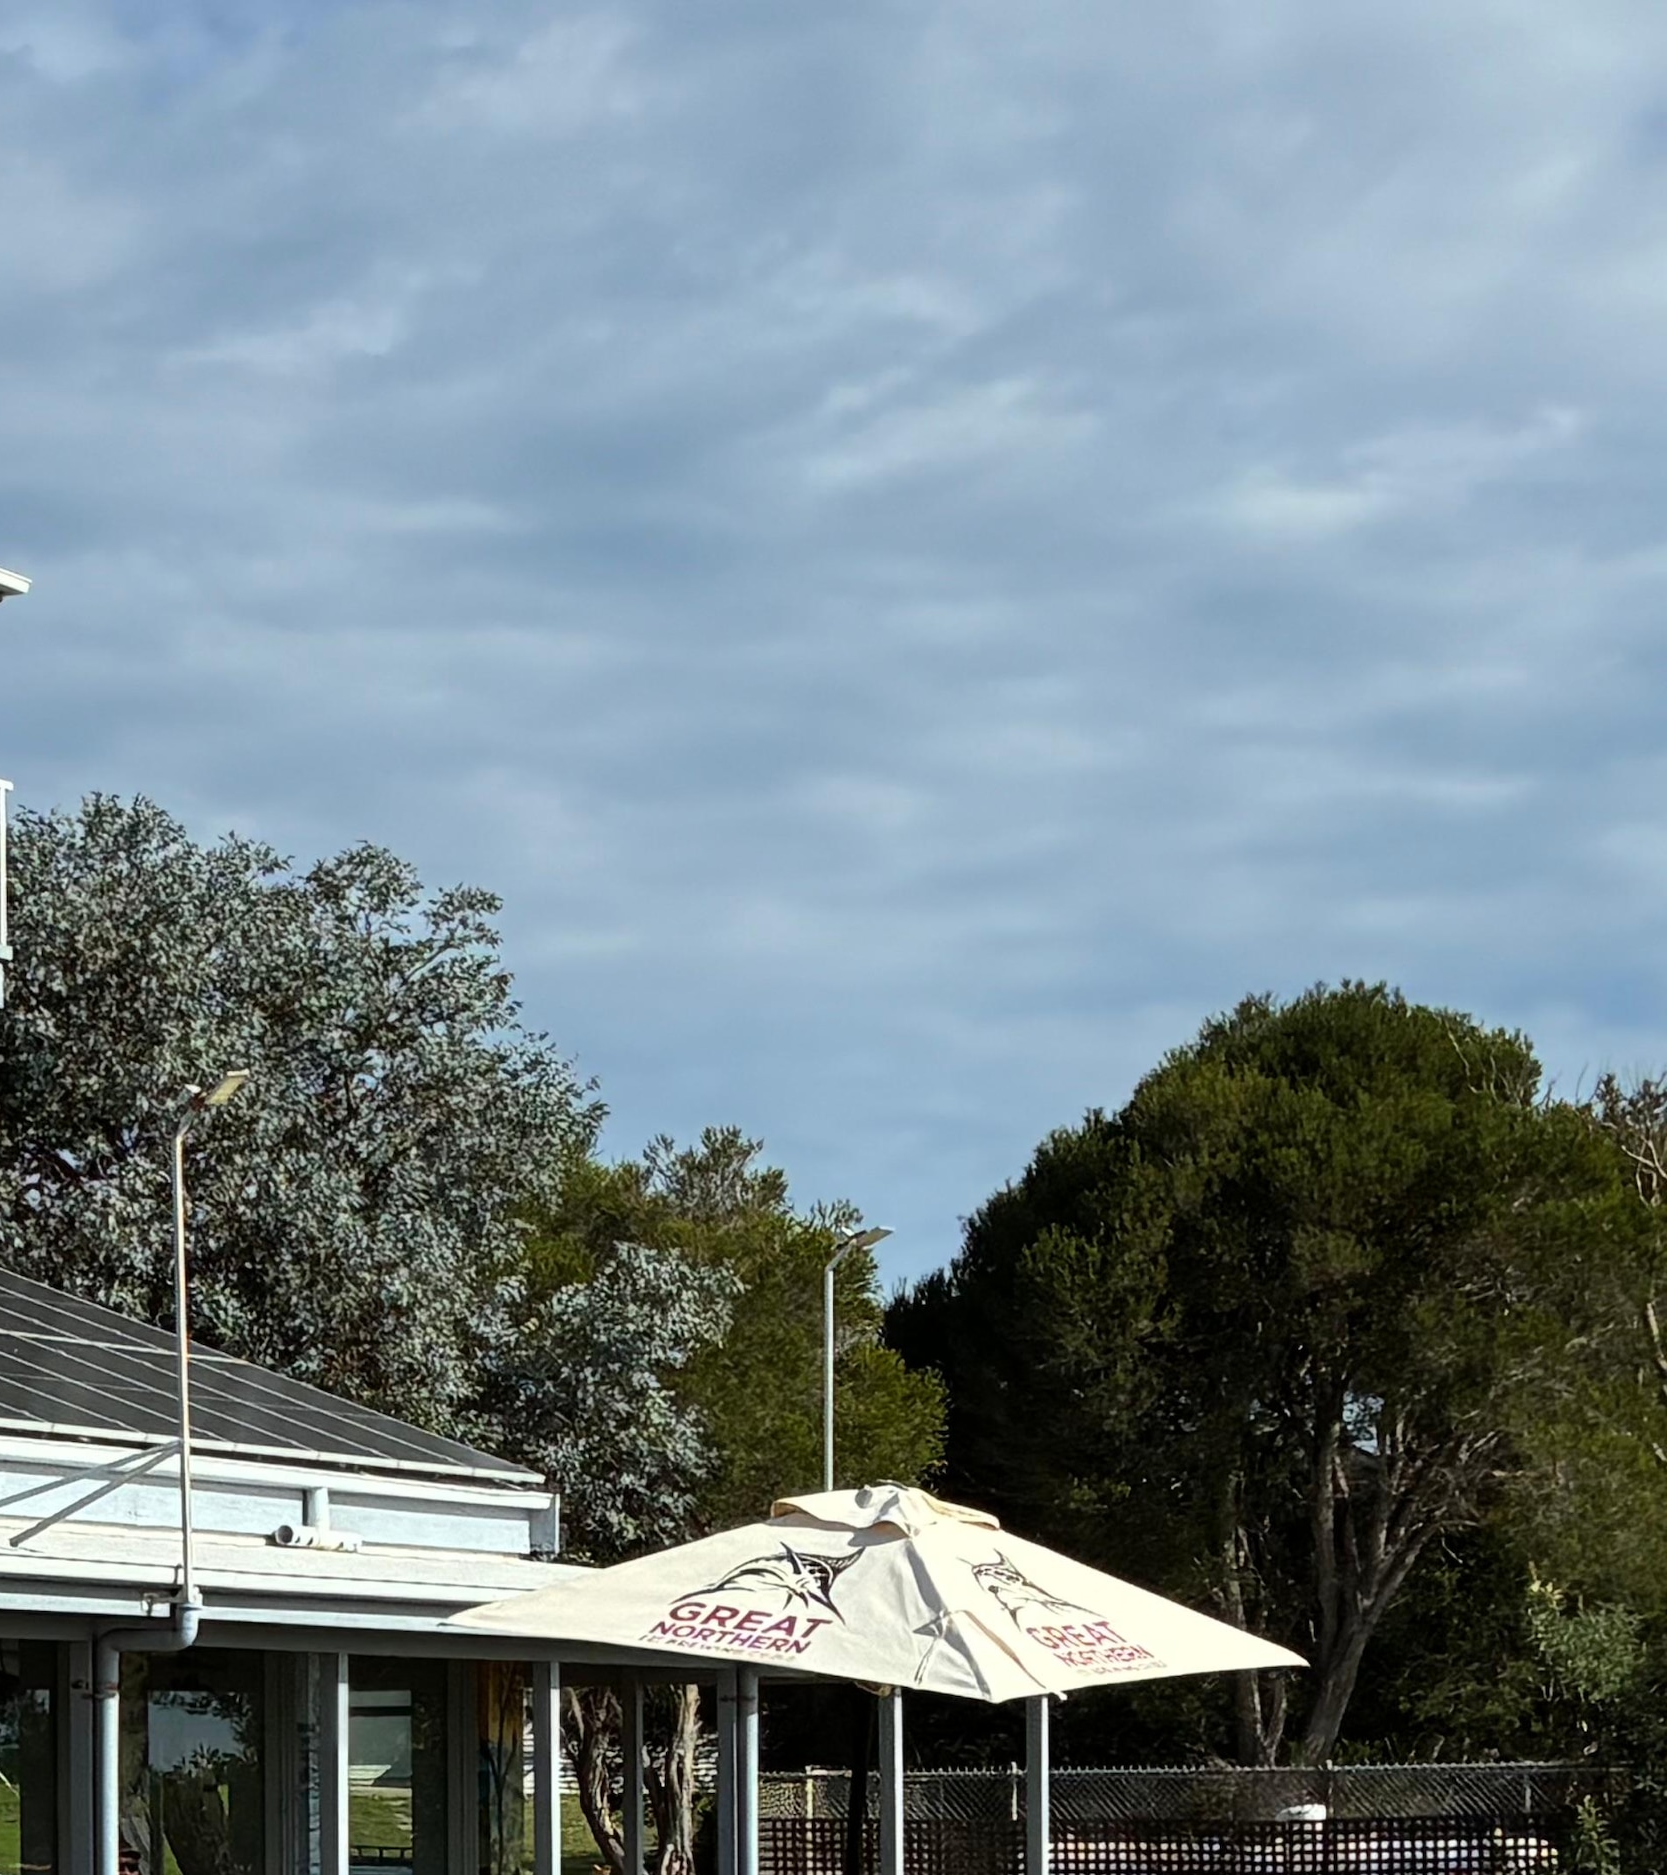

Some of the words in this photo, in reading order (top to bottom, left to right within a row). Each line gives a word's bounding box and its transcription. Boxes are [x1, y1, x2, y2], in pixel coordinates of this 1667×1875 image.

[648, 1620, 812, 1654] NORTHERN
[669, 1601, 834, 1639] GREAT
[1026, 1620, 1128, 1649] GREAT
